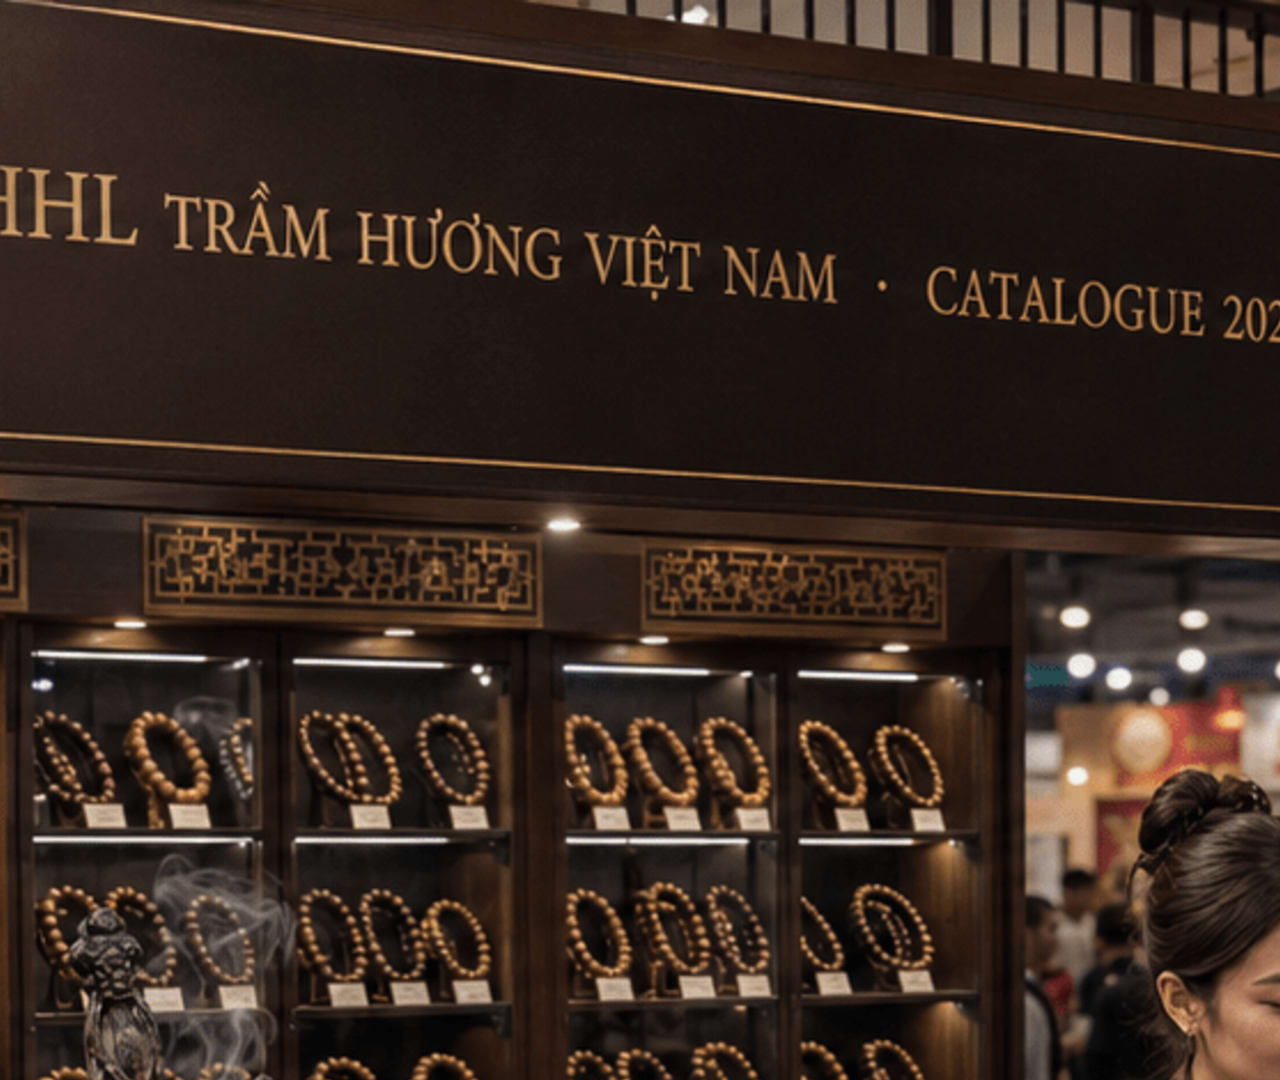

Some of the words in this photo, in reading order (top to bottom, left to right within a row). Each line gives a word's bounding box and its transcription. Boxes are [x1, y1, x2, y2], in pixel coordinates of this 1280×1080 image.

[163, 180, 333, 262] TRẦM
[355, 207, 563, 281] HƯƠNG
[583, 223, 702, 302] VIỆT
[722, 244, 838, 305] NAM
[926, 265, 1205, 337] CATALOGUE
